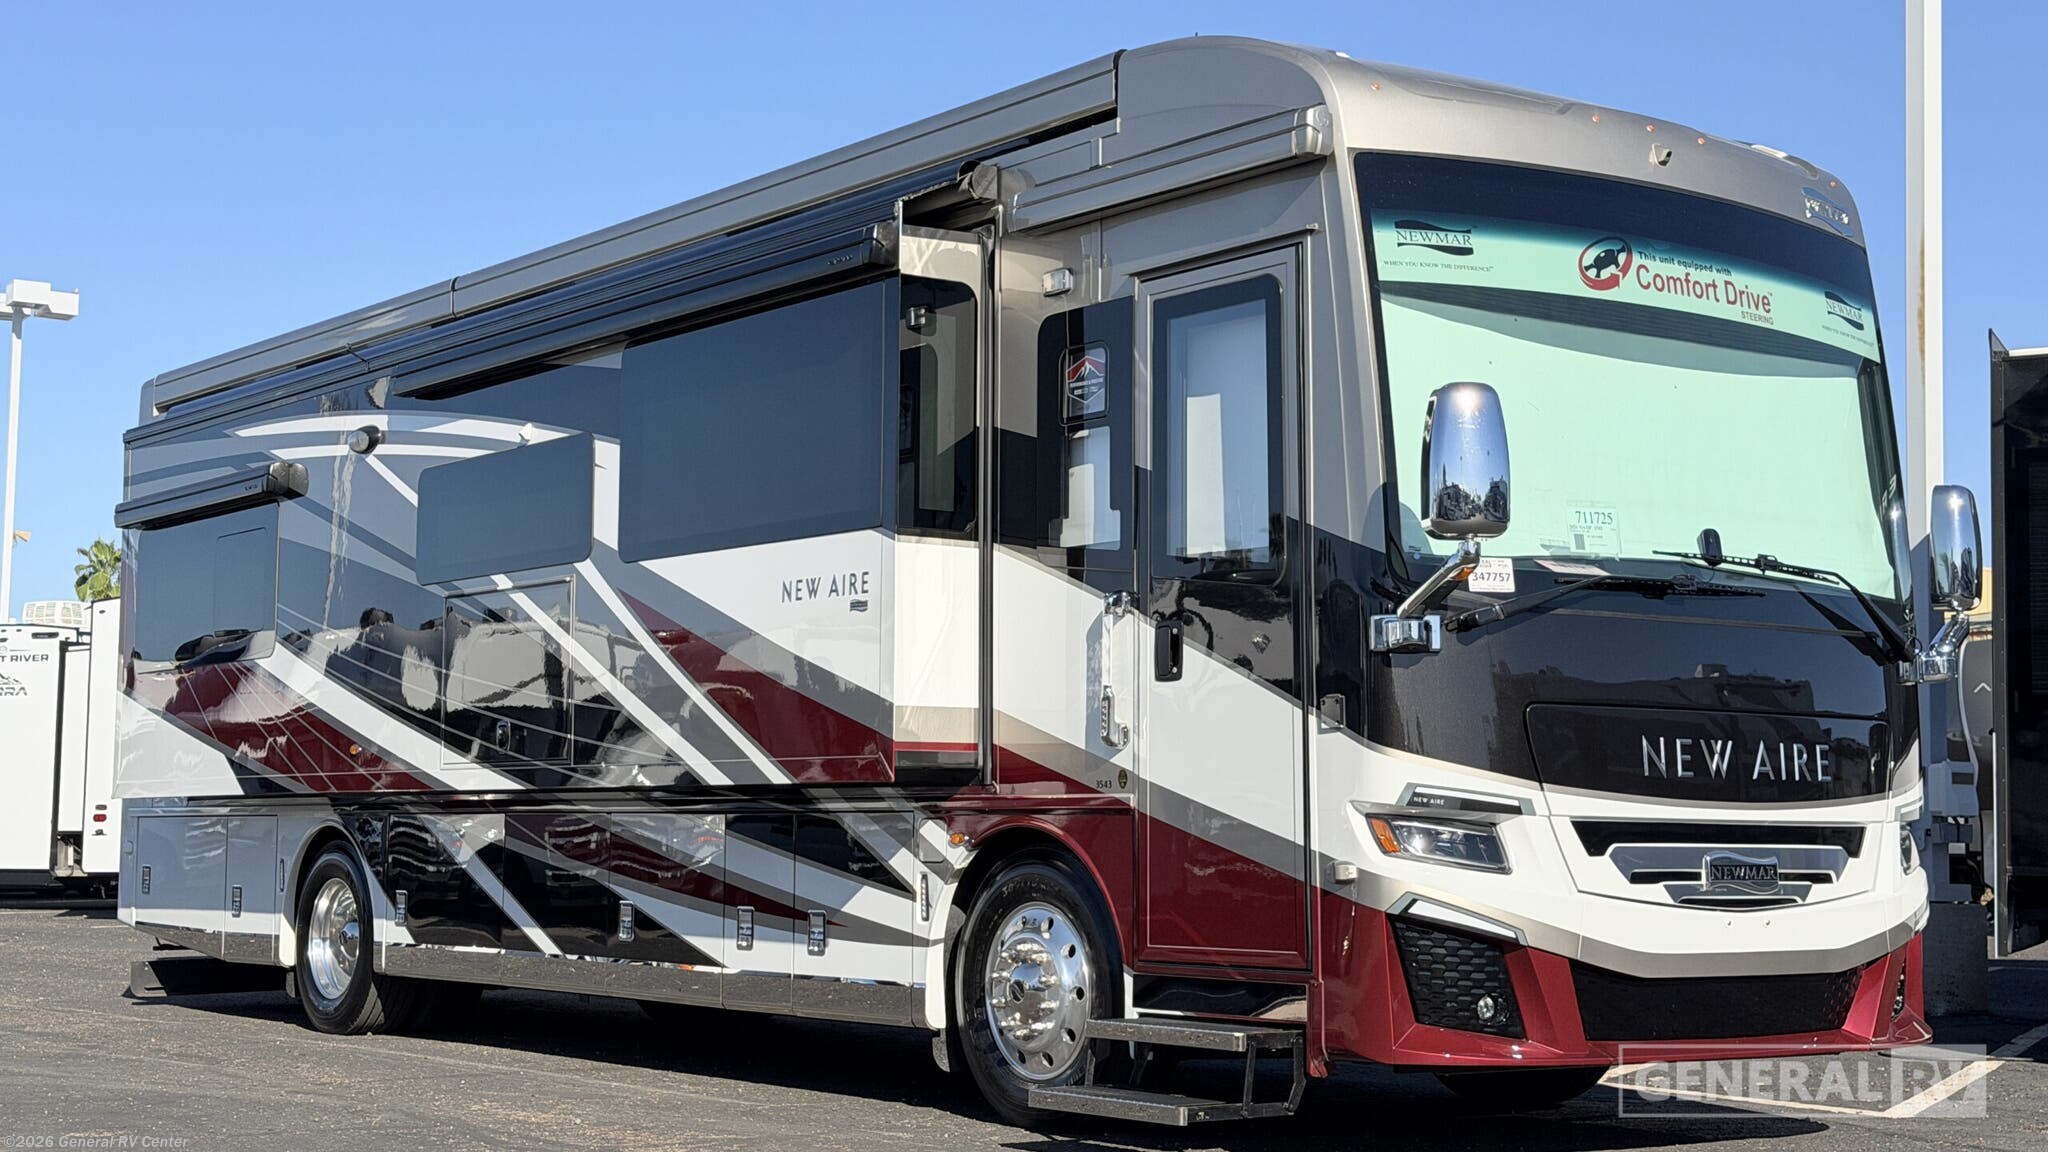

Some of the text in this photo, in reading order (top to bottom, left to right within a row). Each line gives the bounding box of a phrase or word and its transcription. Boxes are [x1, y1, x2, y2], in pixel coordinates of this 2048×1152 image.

[1395, 230, 1472, 246] NEWMAR
[1637, 250, 1732, 277] This unit equipped with
[1636, 263, 1720, 303] Comfort
[1741, 310, 1774, 326] STEERING
[1575, 510, 1613, 525] 711725
[1472, 571, 1511, 582] 347757
[781, 571, 870, 603] NEW AIRE
[10, 654, 49, 662] RIVER
[1641, 734, 1832, 783] NEW AIRE
[1429, 797, 1445, 806] AIRE
[1711, 866, 1779, 880] NEWMAR
